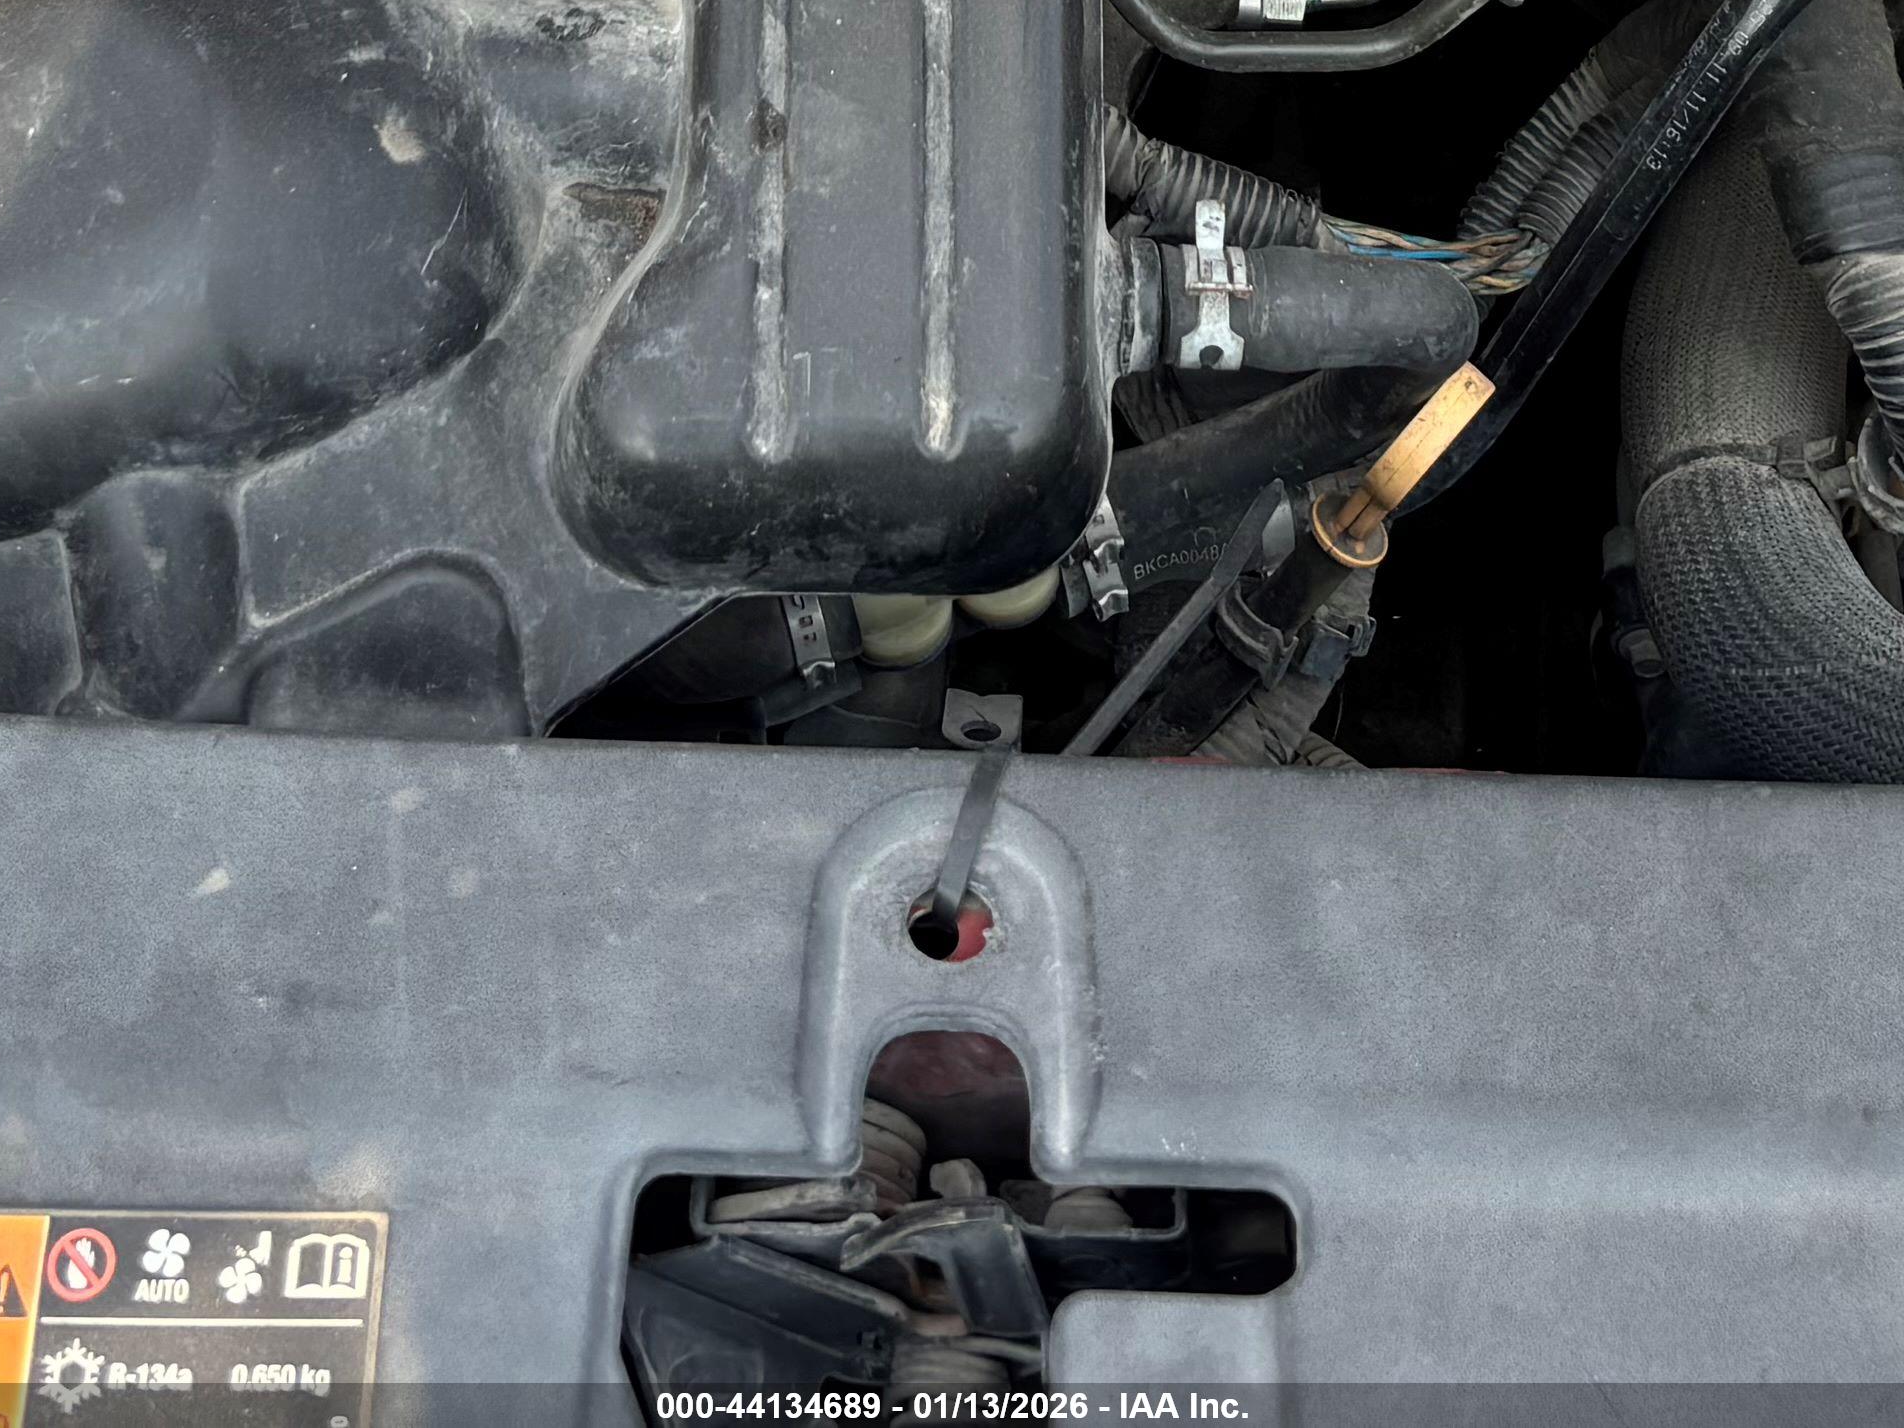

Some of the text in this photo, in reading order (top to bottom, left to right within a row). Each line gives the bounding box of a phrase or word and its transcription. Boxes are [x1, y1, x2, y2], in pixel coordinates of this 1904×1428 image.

[133, 1278, 191, 1304] AUTO
[107, 1361, 332, 1398] R-134a 0.650 kg
